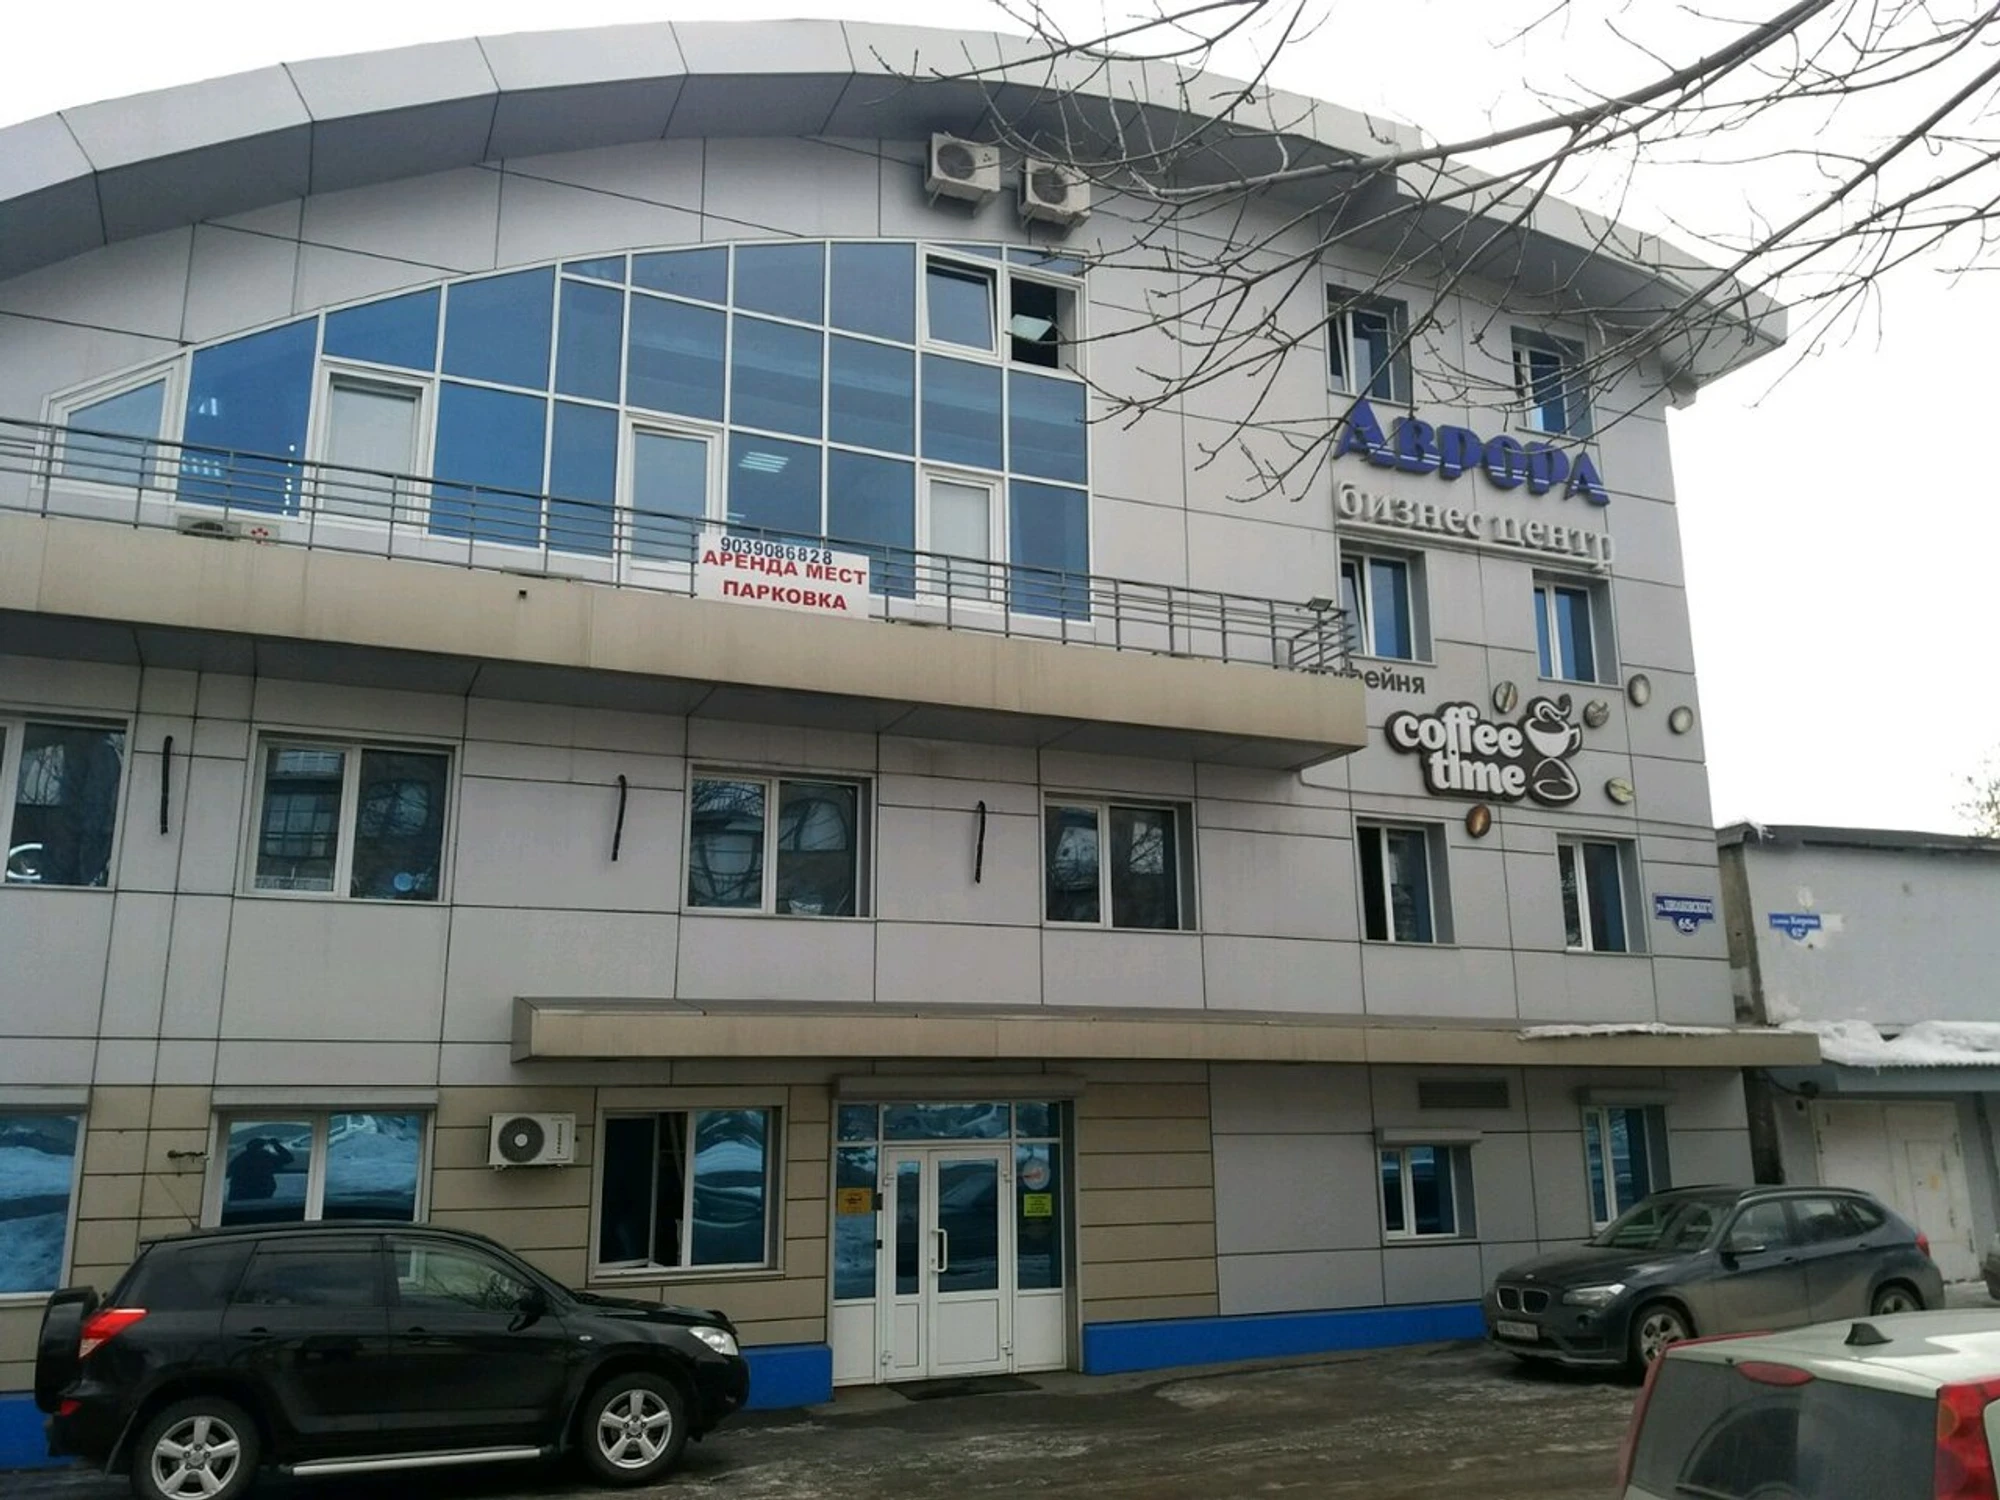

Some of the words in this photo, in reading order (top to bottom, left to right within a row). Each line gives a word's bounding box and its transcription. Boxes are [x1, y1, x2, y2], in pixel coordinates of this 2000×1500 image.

[1333, 398, 1610, 508] АВРОРА
[1338, 481, 1484, 538] бизнес
[1490, 513, 1615, 572] центр
[702, 550, 798, 577] АРЕНДА
[806, 563, 867, 585] МЕСТ
[720, 537, 833, 566] 9039086828
[723, 580, 847, 611] ПАРКОВКА
[1393, 705, 1524, 759] coffee
[1429, 748, 1526, 797] time
